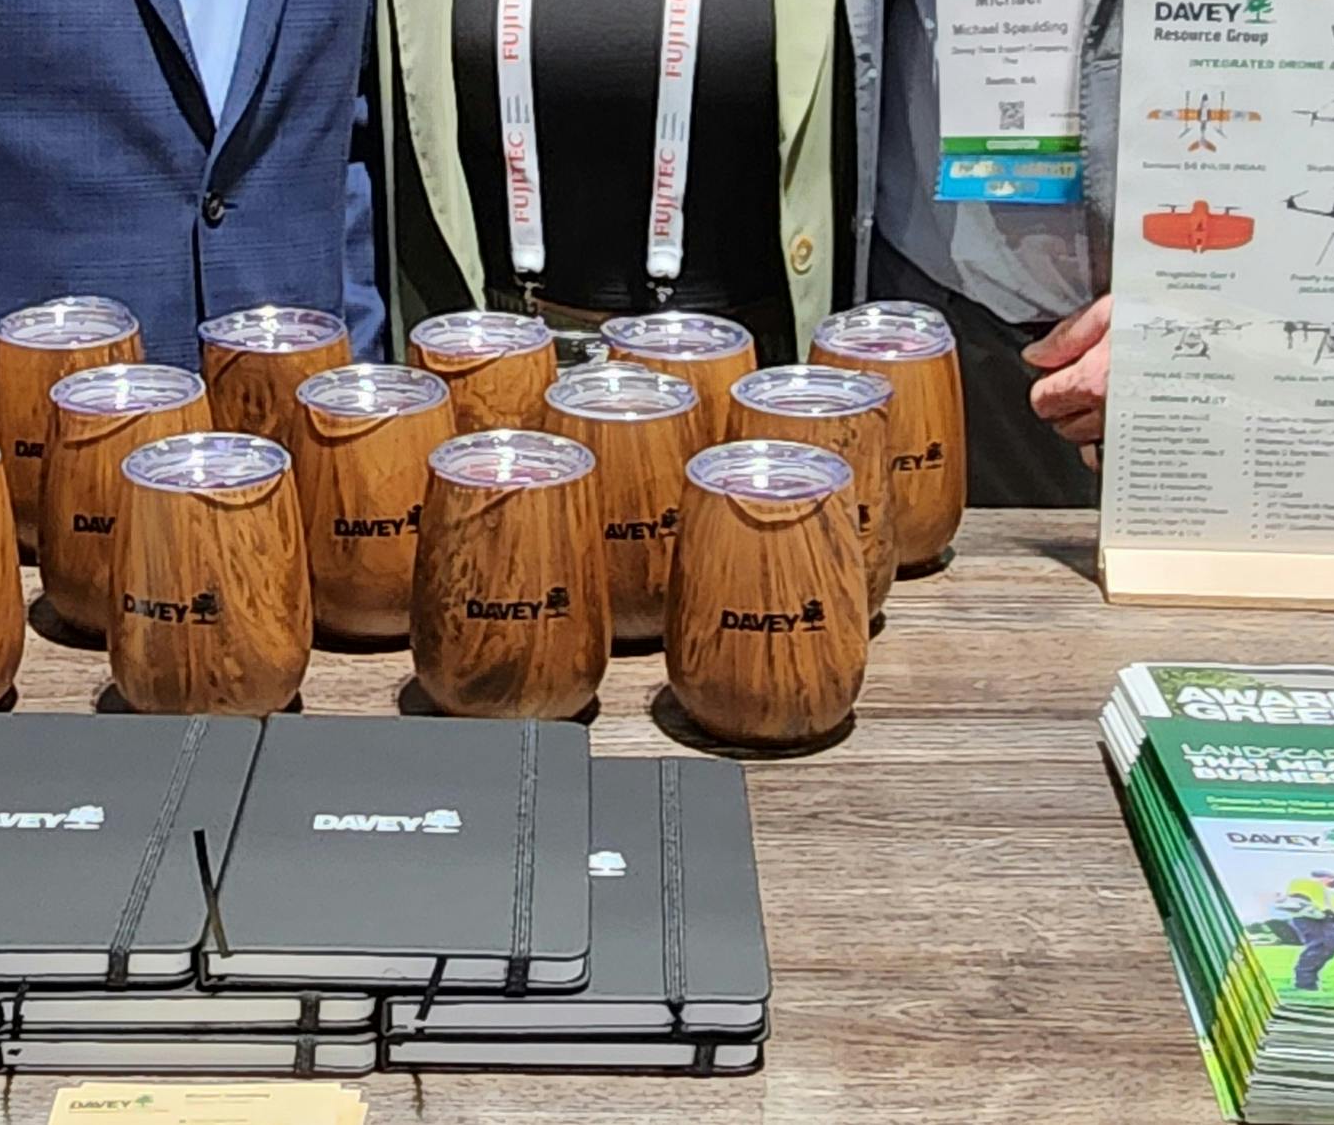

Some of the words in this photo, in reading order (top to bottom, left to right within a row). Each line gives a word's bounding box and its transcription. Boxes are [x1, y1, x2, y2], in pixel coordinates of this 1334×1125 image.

[1154, 1, 1242, 23] DAVEY
[1153, 27, 1222, 43] Resource
[1225, 27, 1269, 46] Group
[1189, 57, 1275, 70] INTEGRATED
[507, 130, 531, 224] FUJITEC
[653, 148, 677, 238] FUJITEC
[73, 514, 116, 535] DAV
[333, 516, 405, 539] DAVEY
[605, 519, 659, 541] AVEY
[124, 593, 189, 624] DAVEY
[467, 598, 543, 621] DAVEY
[720, 609, 800, 634] DAVEY
[312, 813, 424, 834] DAVEY
[1226, 831, 1321, 847] DAVEY
[69, 1098, 132, 1111] DAVEY
